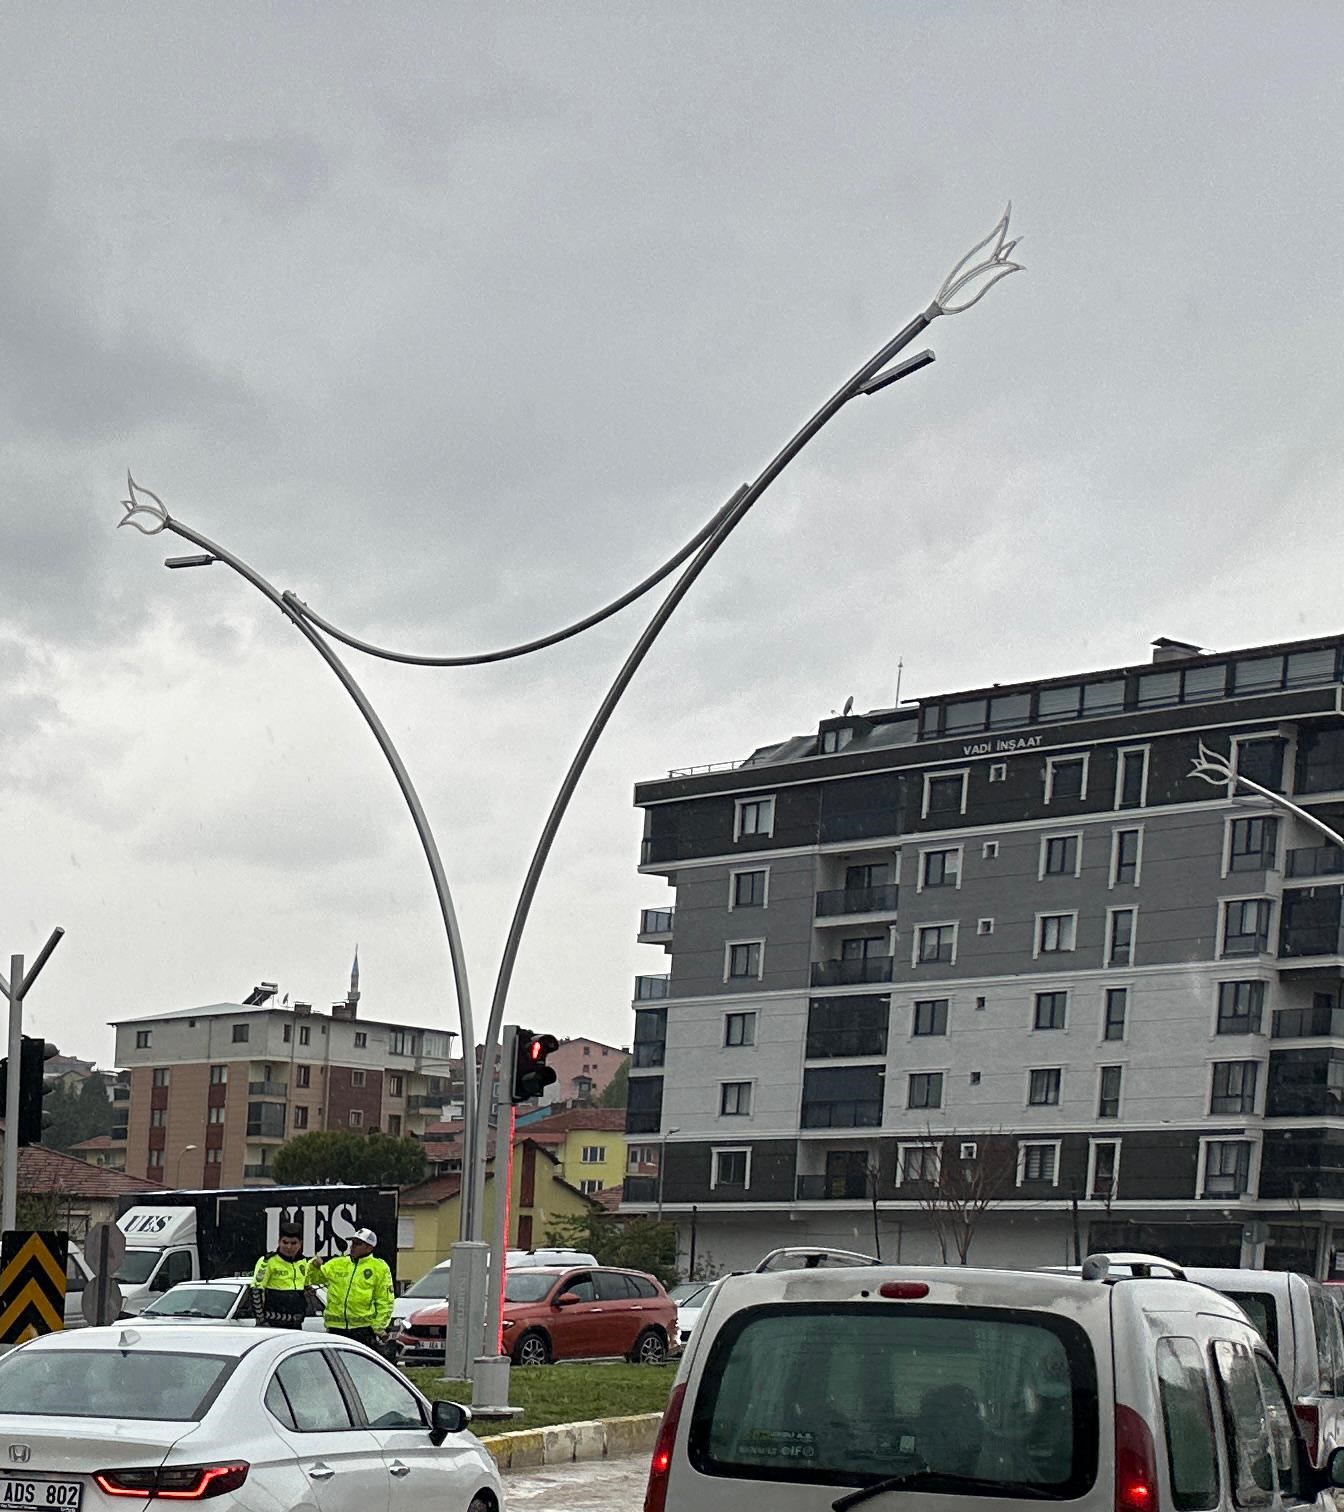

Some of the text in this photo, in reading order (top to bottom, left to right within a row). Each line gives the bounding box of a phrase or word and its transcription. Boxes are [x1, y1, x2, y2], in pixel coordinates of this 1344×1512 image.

[963, 736, 1043, 755] VADİ İNŞAAT
[123, 1215, 173, 1233] UES
[265, 1203, 357, 1258] UES
[4, 1482, 35, 1503] ADS
[46, 1485, 78, 1506] 802
